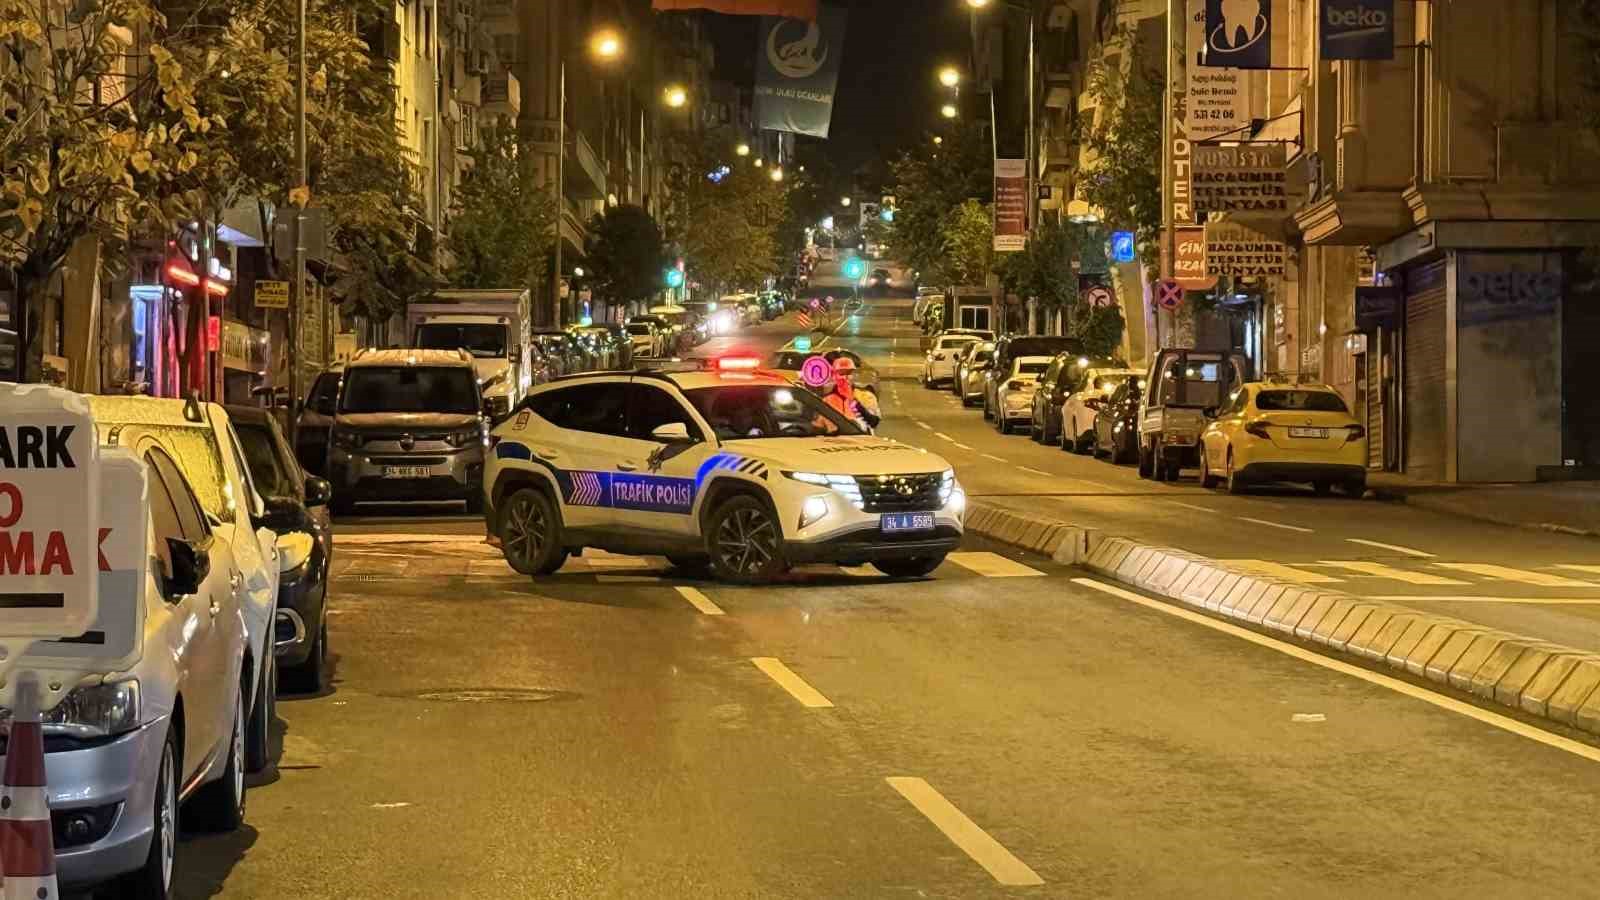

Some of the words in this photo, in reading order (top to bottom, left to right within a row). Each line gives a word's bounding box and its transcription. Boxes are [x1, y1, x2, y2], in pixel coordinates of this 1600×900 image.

[1327, 6, 1386, 26] beko
[1173, 118, 1190, 220] NOTER
[614, 479, 654, 503] TRAFİK
[656, 483, 691, 506] POLİSİ
[887, 517, 896, 529] 34
[0, 531, 74, 575] MA
